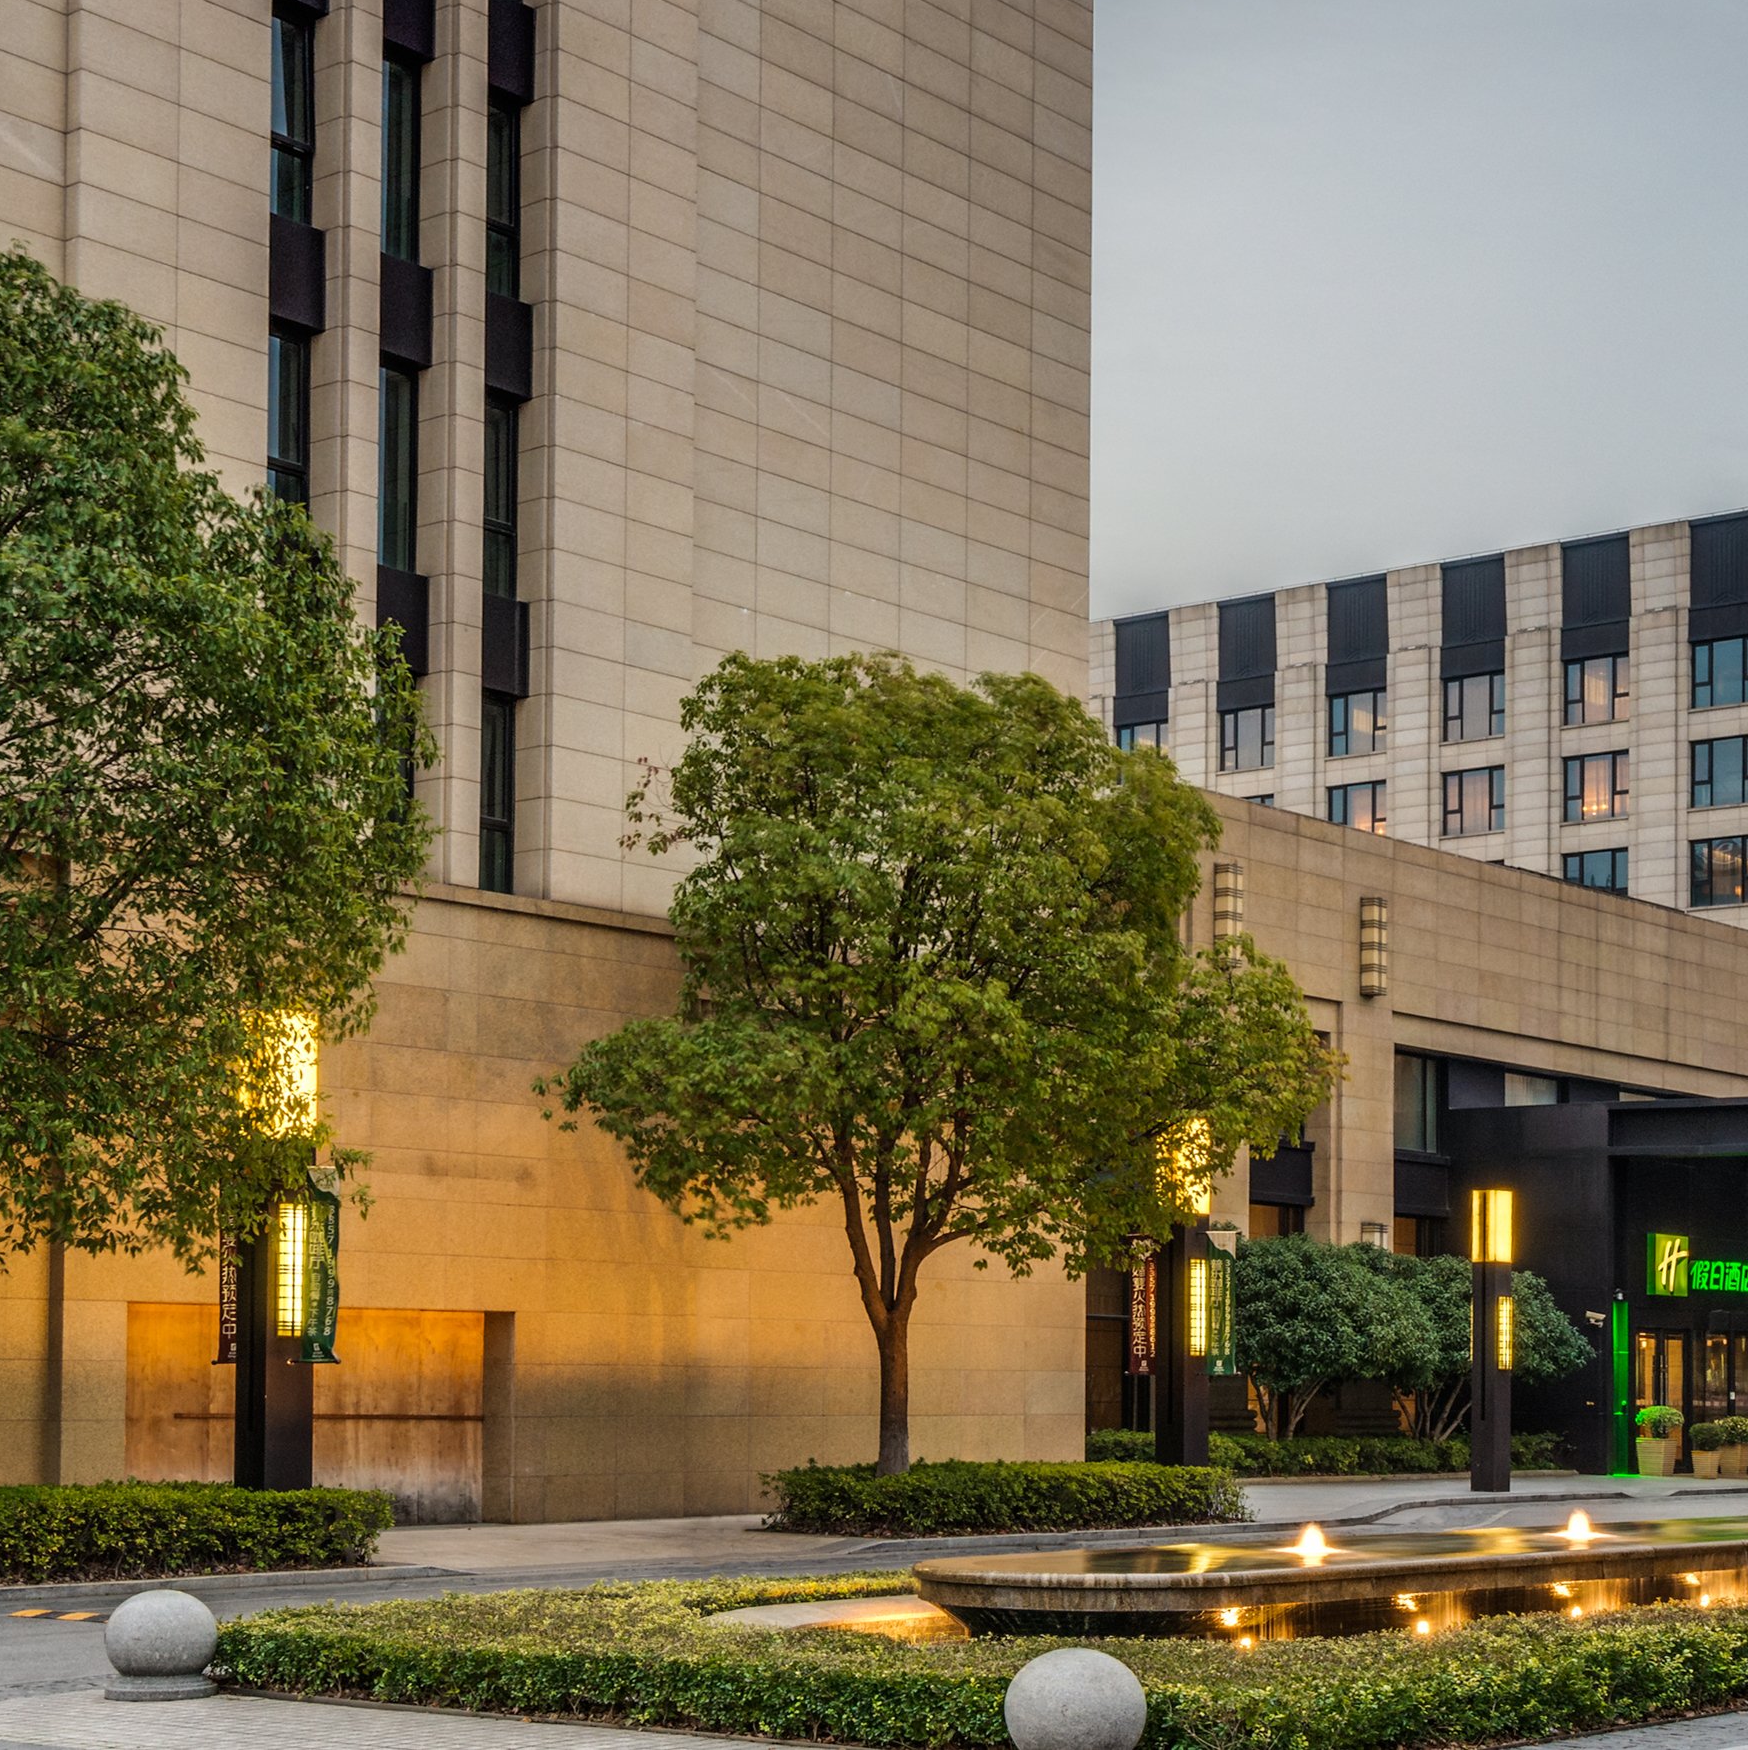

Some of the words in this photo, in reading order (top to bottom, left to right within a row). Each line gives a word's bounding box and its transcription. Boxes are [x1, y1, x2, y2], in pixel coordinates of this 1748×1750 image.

[221, 1215, 237, 1339] 宴火热预定中
